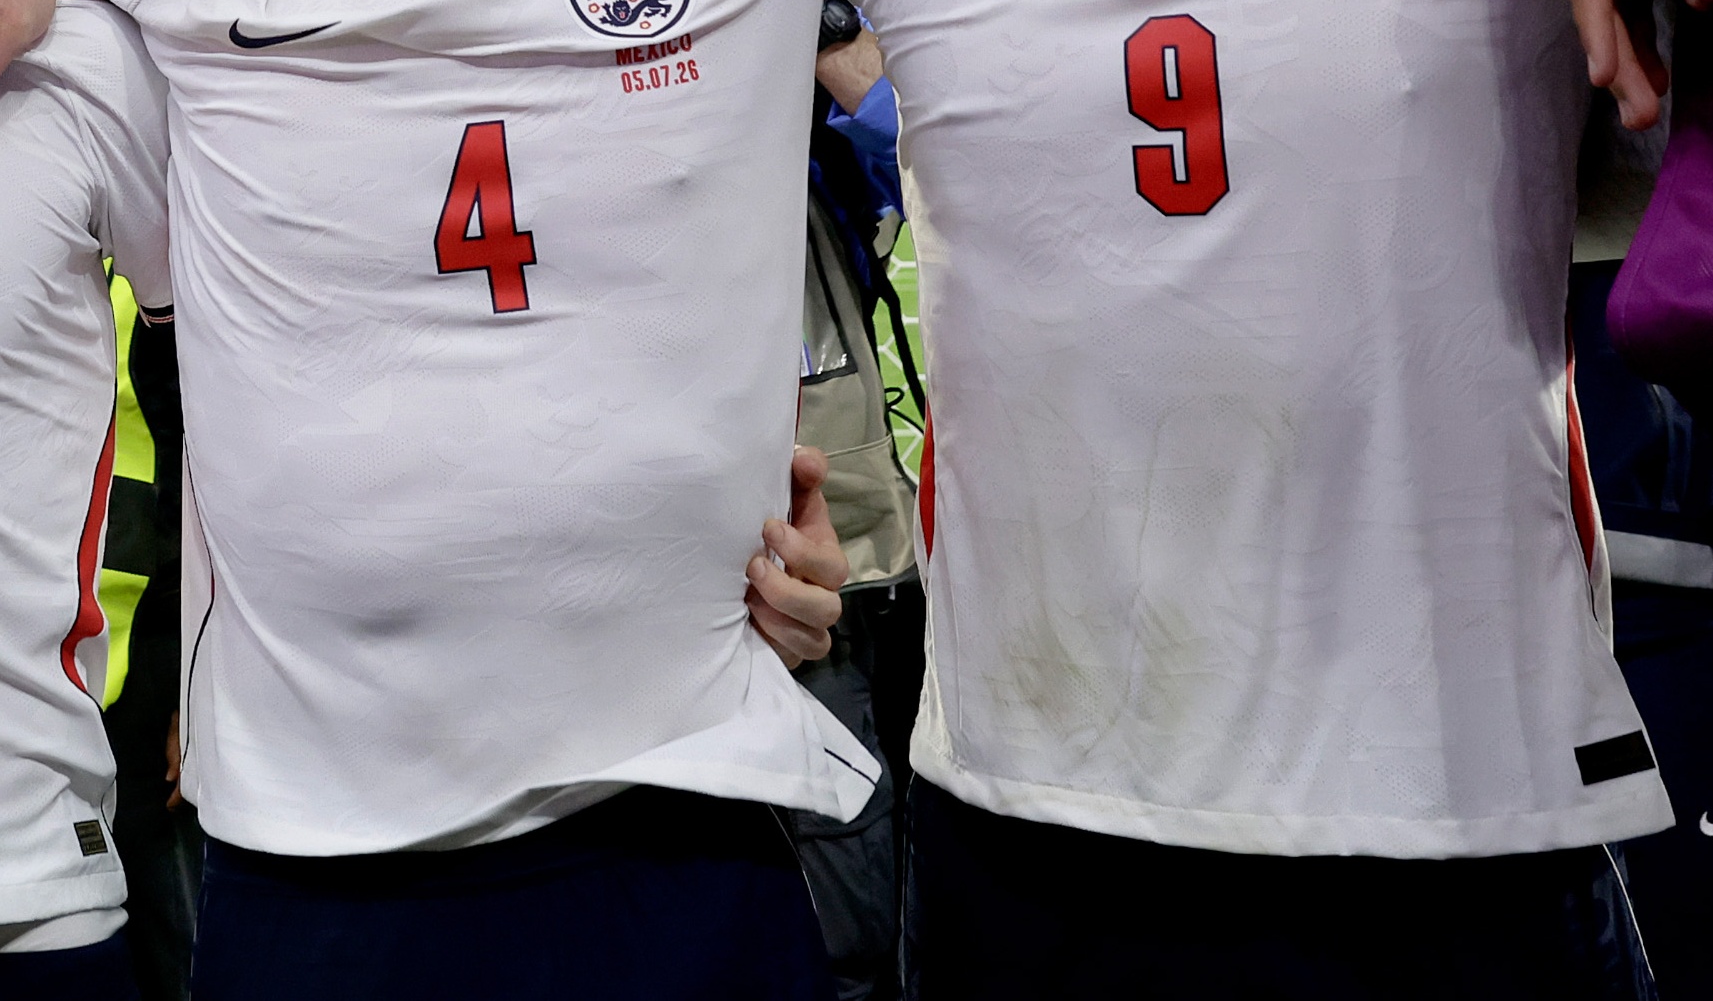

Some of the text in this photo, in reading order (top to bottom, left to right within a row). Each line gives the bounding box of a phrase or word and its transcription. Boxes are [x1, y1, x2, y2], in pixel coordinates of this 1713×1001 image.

[621, 59, 699, 94] 05.07.26
[1124, 14, 1230, 217] 9
[433, 120, 538, 314] 4
